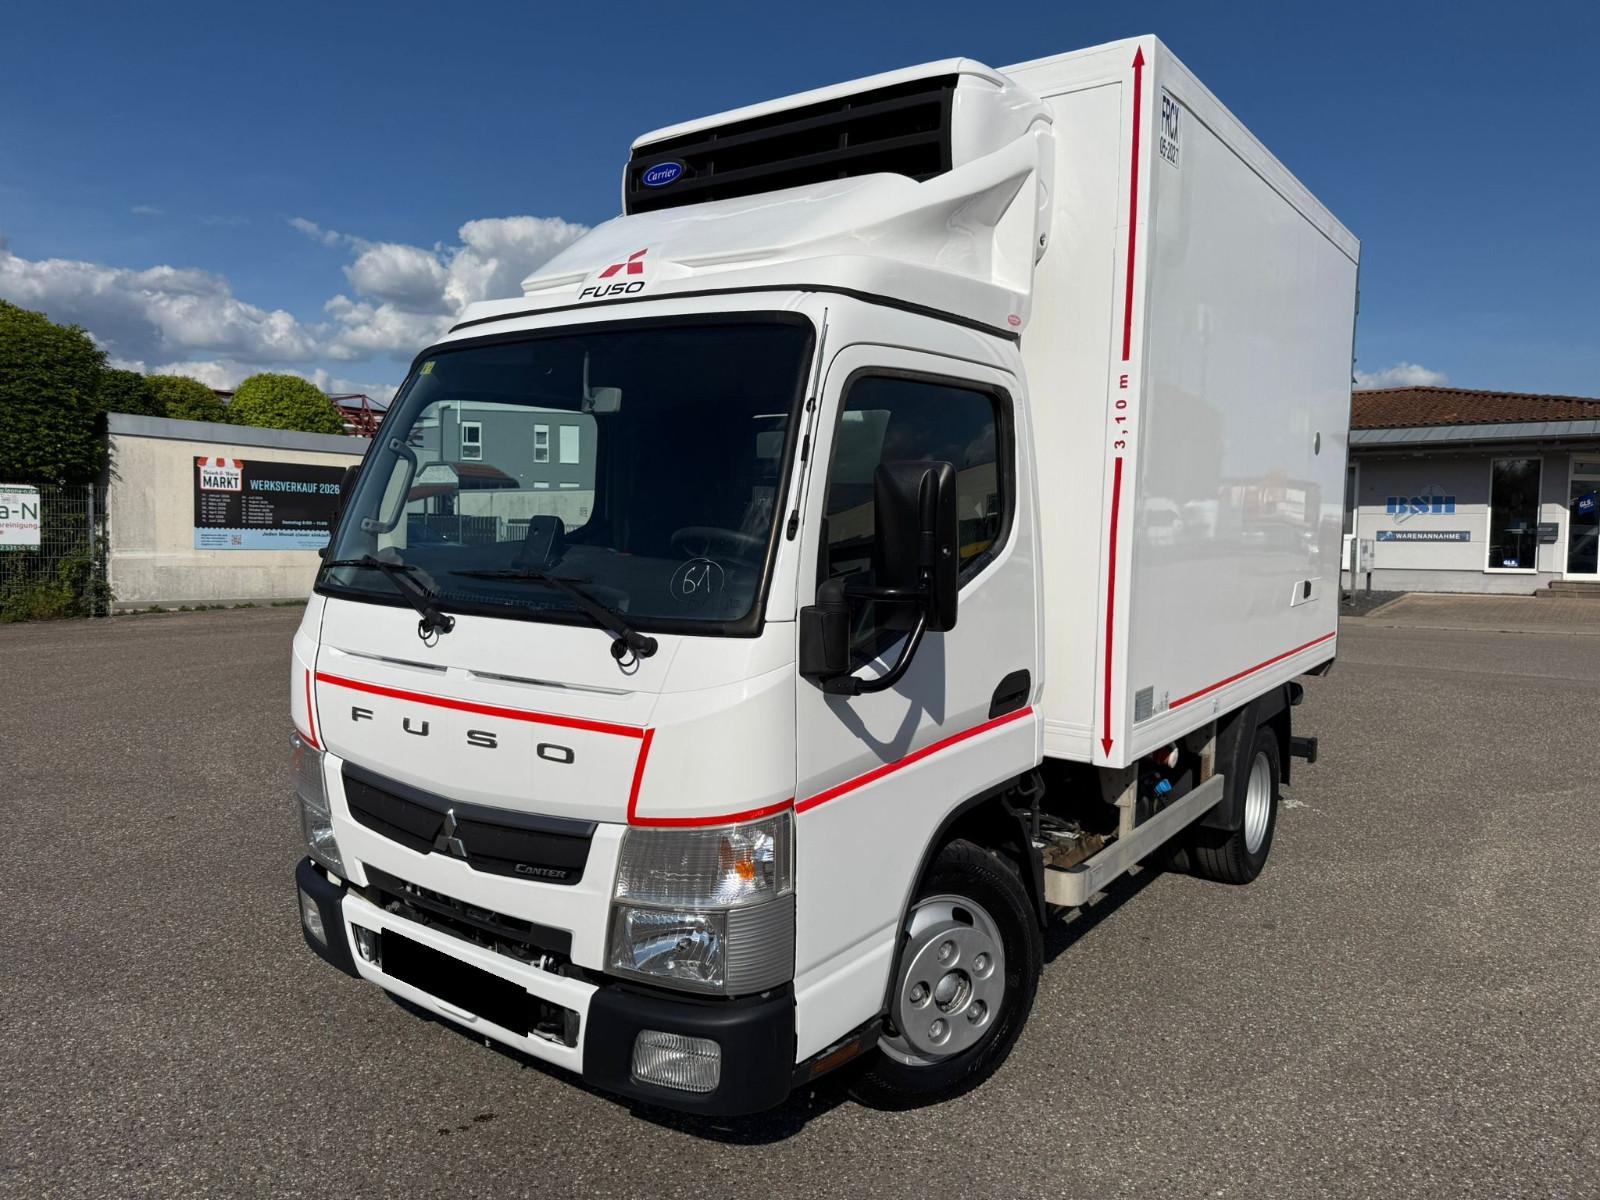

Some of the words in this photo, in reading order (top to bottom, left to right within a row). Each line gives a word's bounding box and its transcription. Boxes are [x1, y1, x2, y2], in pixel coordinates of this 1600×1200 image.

[1162, 95, 1180, 144] FRCX
[647, 168, 677, 182] Carrier
[578, 281, 646, 300] FUSO
[1119, 374, 1129, 389] m
[1114, 399, 1129, 449] 3,10
[203, 475, 239, 489] MARKT
[249, 479, 318, 493] WERKSVERKAUF
[319, 483, 341, 495] 2026
[1384, 495, 1457, 515] BSH
[1395, 532, 1461, 540] WARENANNAHME
[682, 564, 711, 594] 61
[351, 706, 575, 765] FUSO
[514, 863, 567, 879] CANTER
